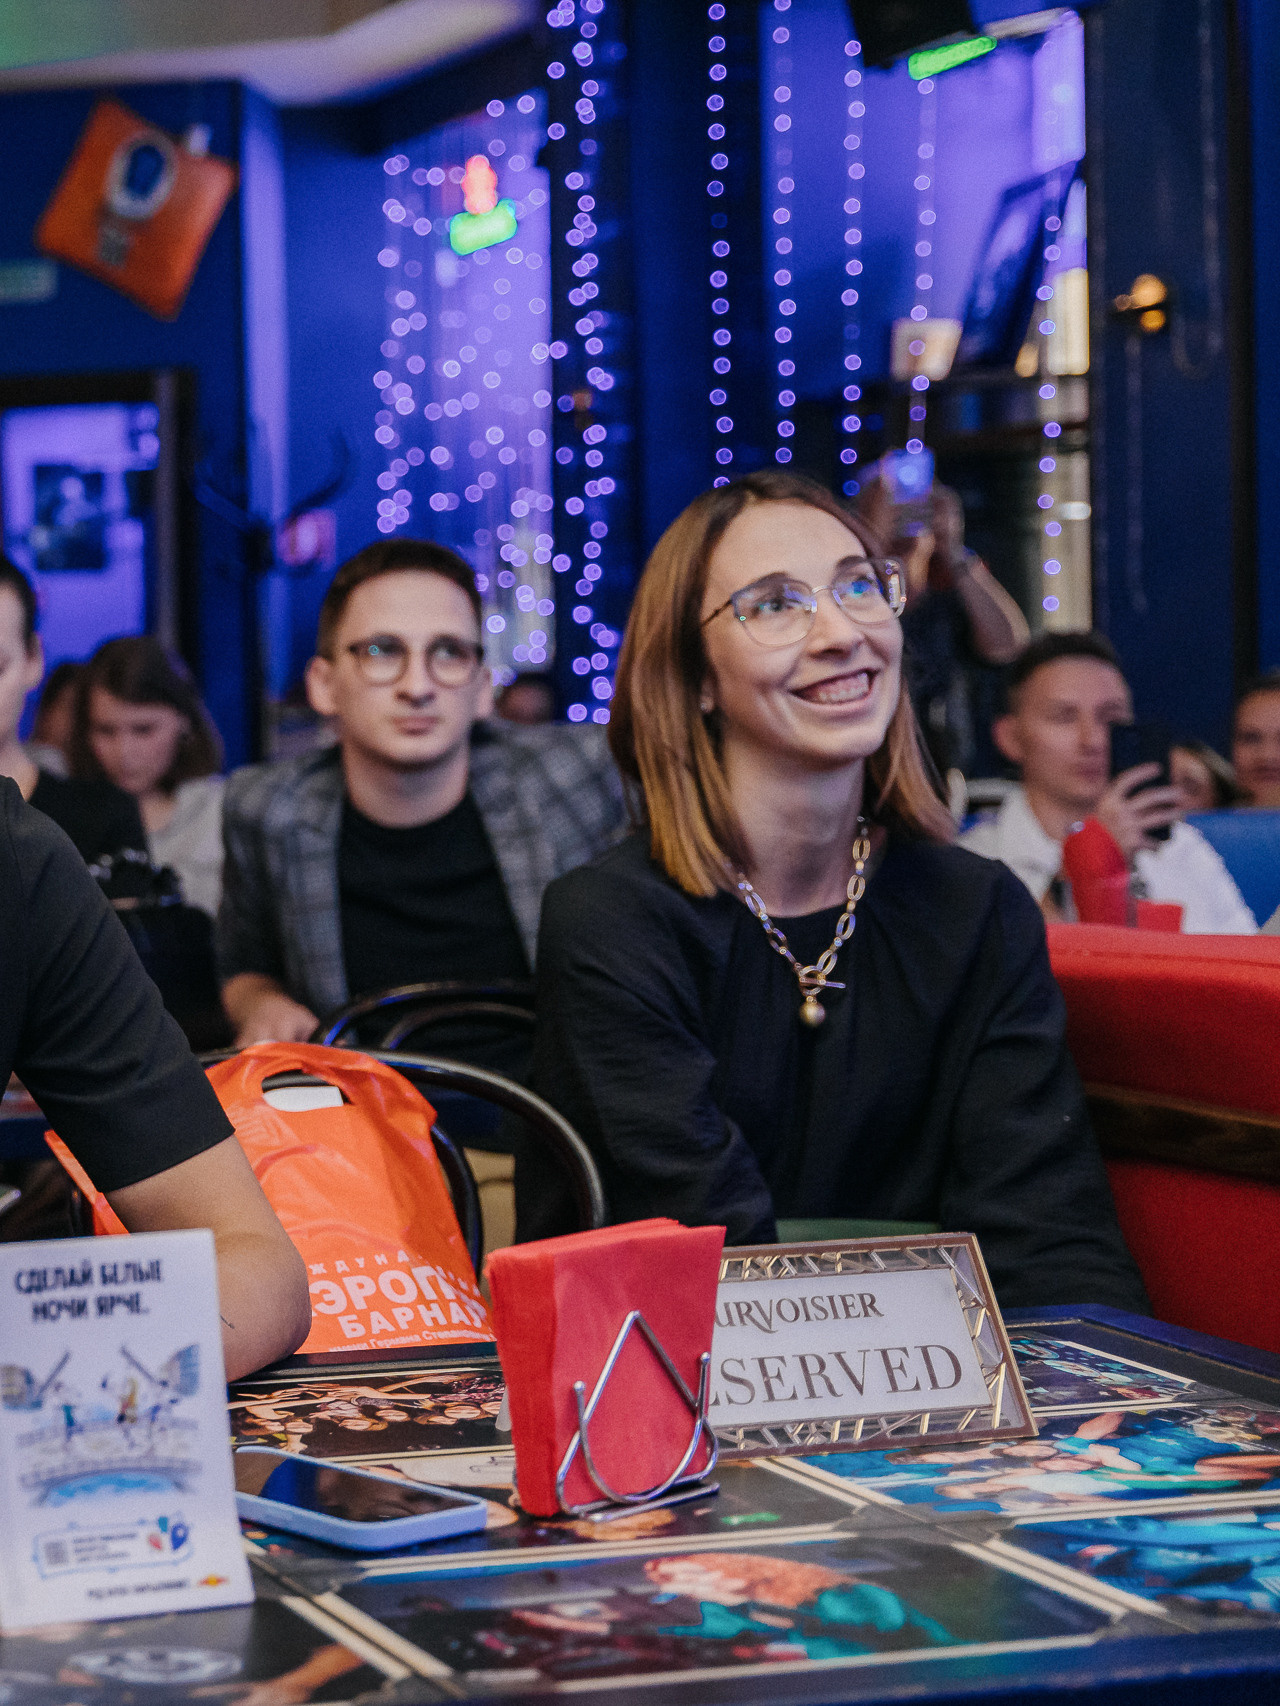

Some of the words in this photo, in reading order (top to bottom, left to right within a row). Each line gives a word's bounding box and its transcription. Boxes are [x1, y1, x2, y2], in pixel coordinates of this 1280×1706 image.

[15, 1259, 93, 1294] СДЕЛАЙ
[100, 1259, 162, 1286] БЕЛЫЕ
[309, 1264, 465, 1317] ЭРОП
[33, 1298, 87, 1323] НОЧИ
[714, 1292, 885, 1334] URVOISIER
